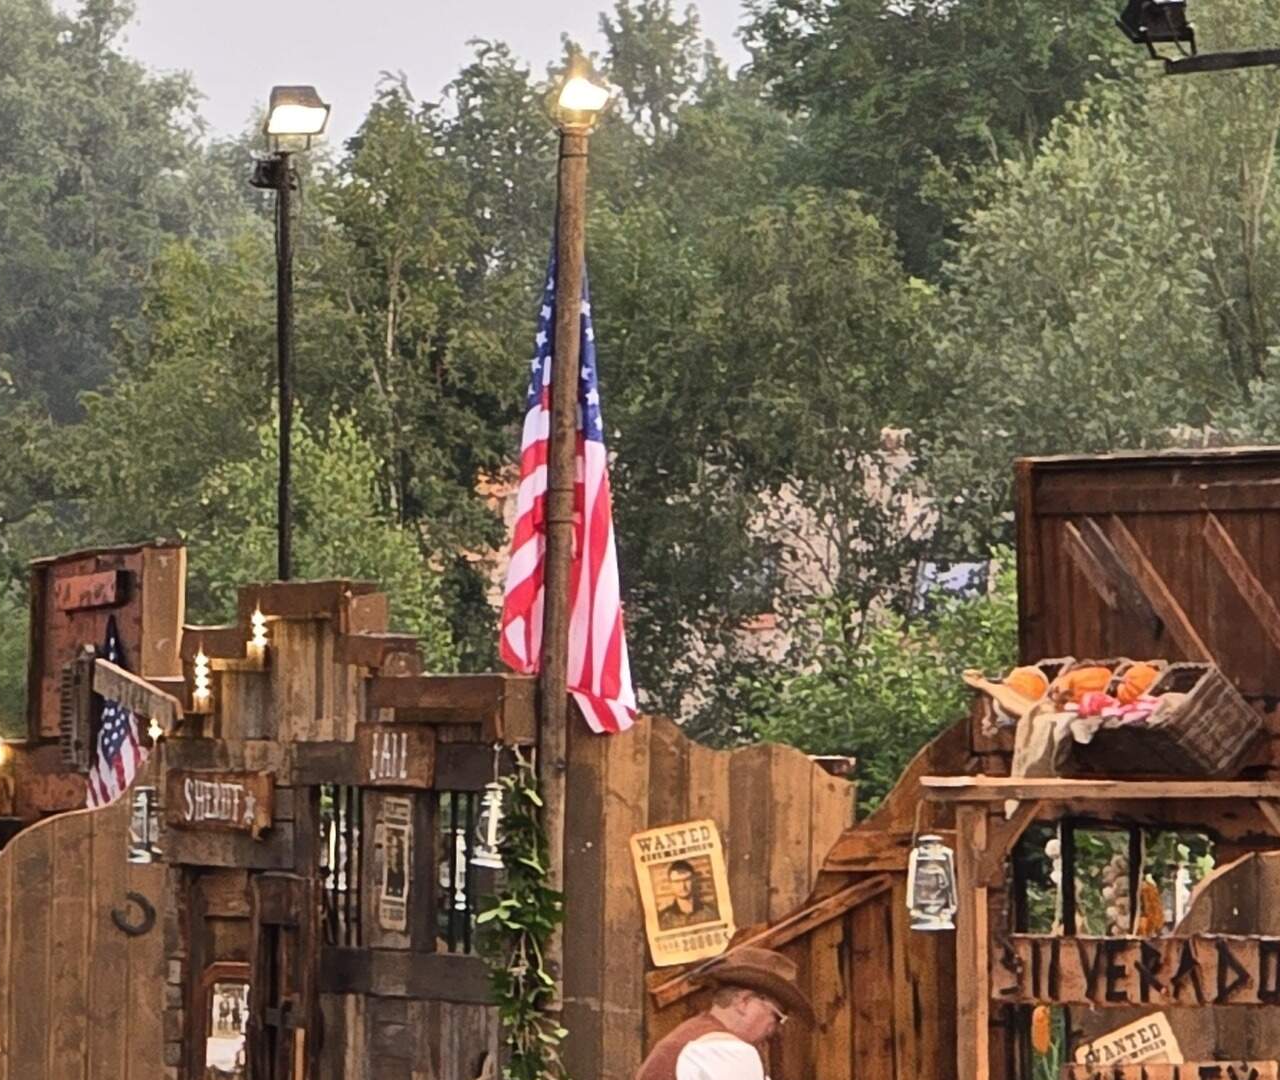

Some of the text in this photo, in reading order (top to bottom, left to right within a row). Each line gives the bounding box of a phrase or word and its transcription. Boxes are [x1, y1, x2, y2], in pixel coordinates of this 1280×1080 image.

[369, 732, 408, 780] JAIL
[184, 778, 244, 821] SHERIFF
[636, 826, 711, 853] WANTED
